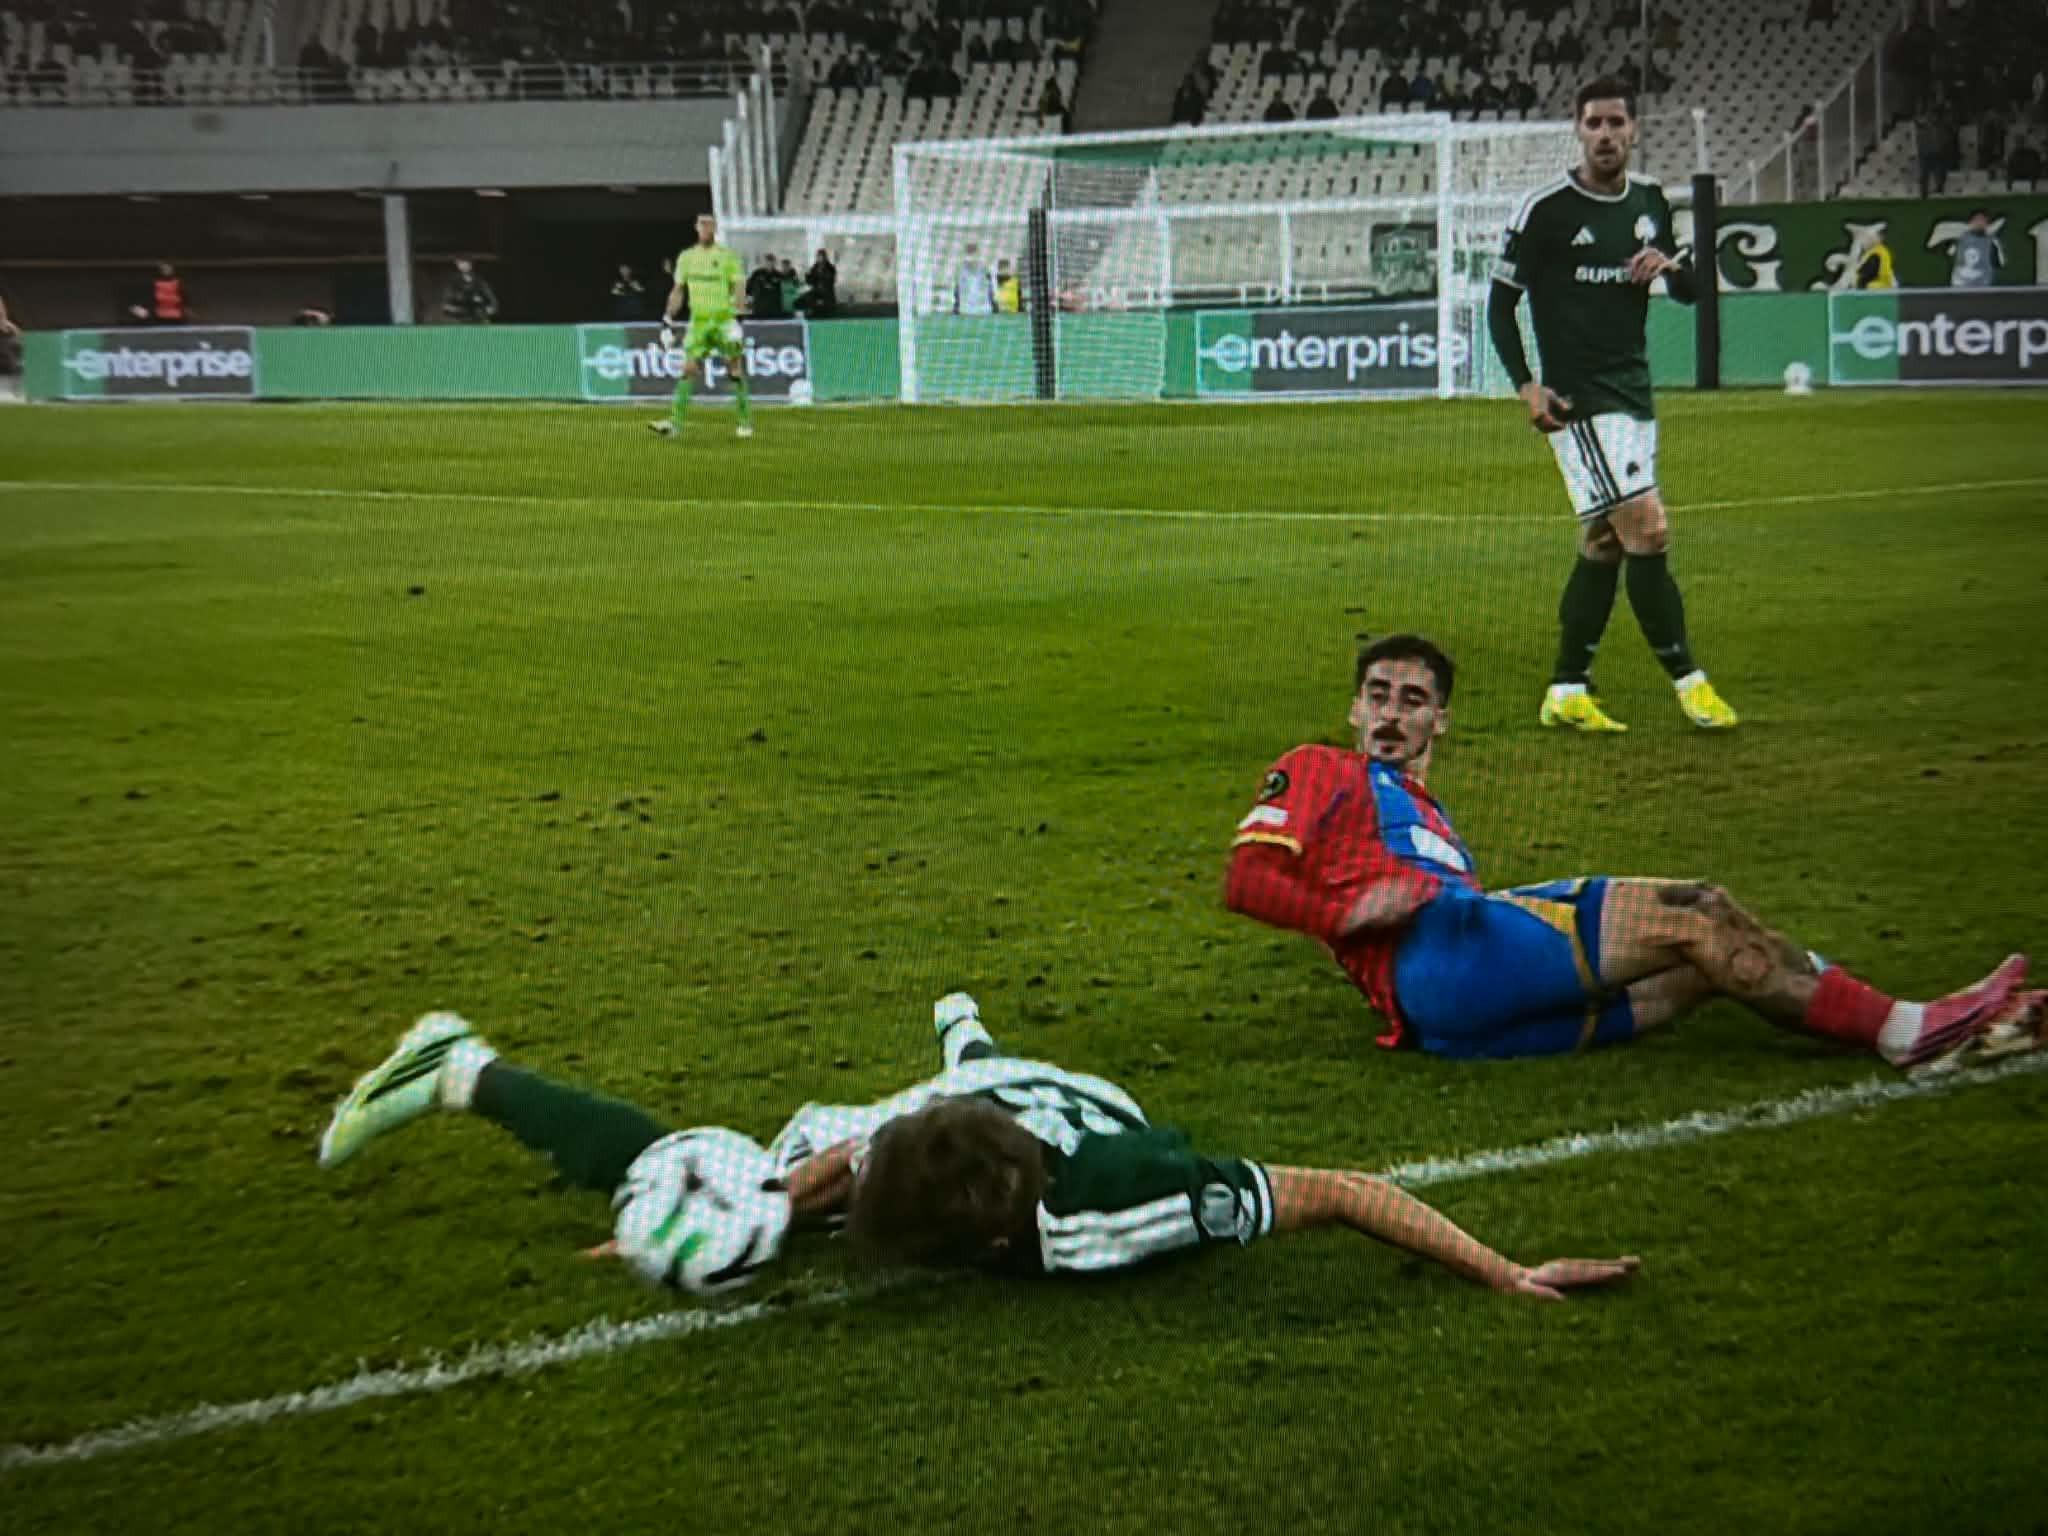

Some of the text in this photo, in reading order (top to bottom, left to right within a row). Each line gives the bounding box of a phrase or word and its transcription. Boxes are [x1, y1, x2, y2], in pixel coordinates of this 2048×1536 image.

[1574, 264, 1632, 283] SUPE
[66, 340, 251, 387] enterprise
[586, 336, 804, 388] entepise
